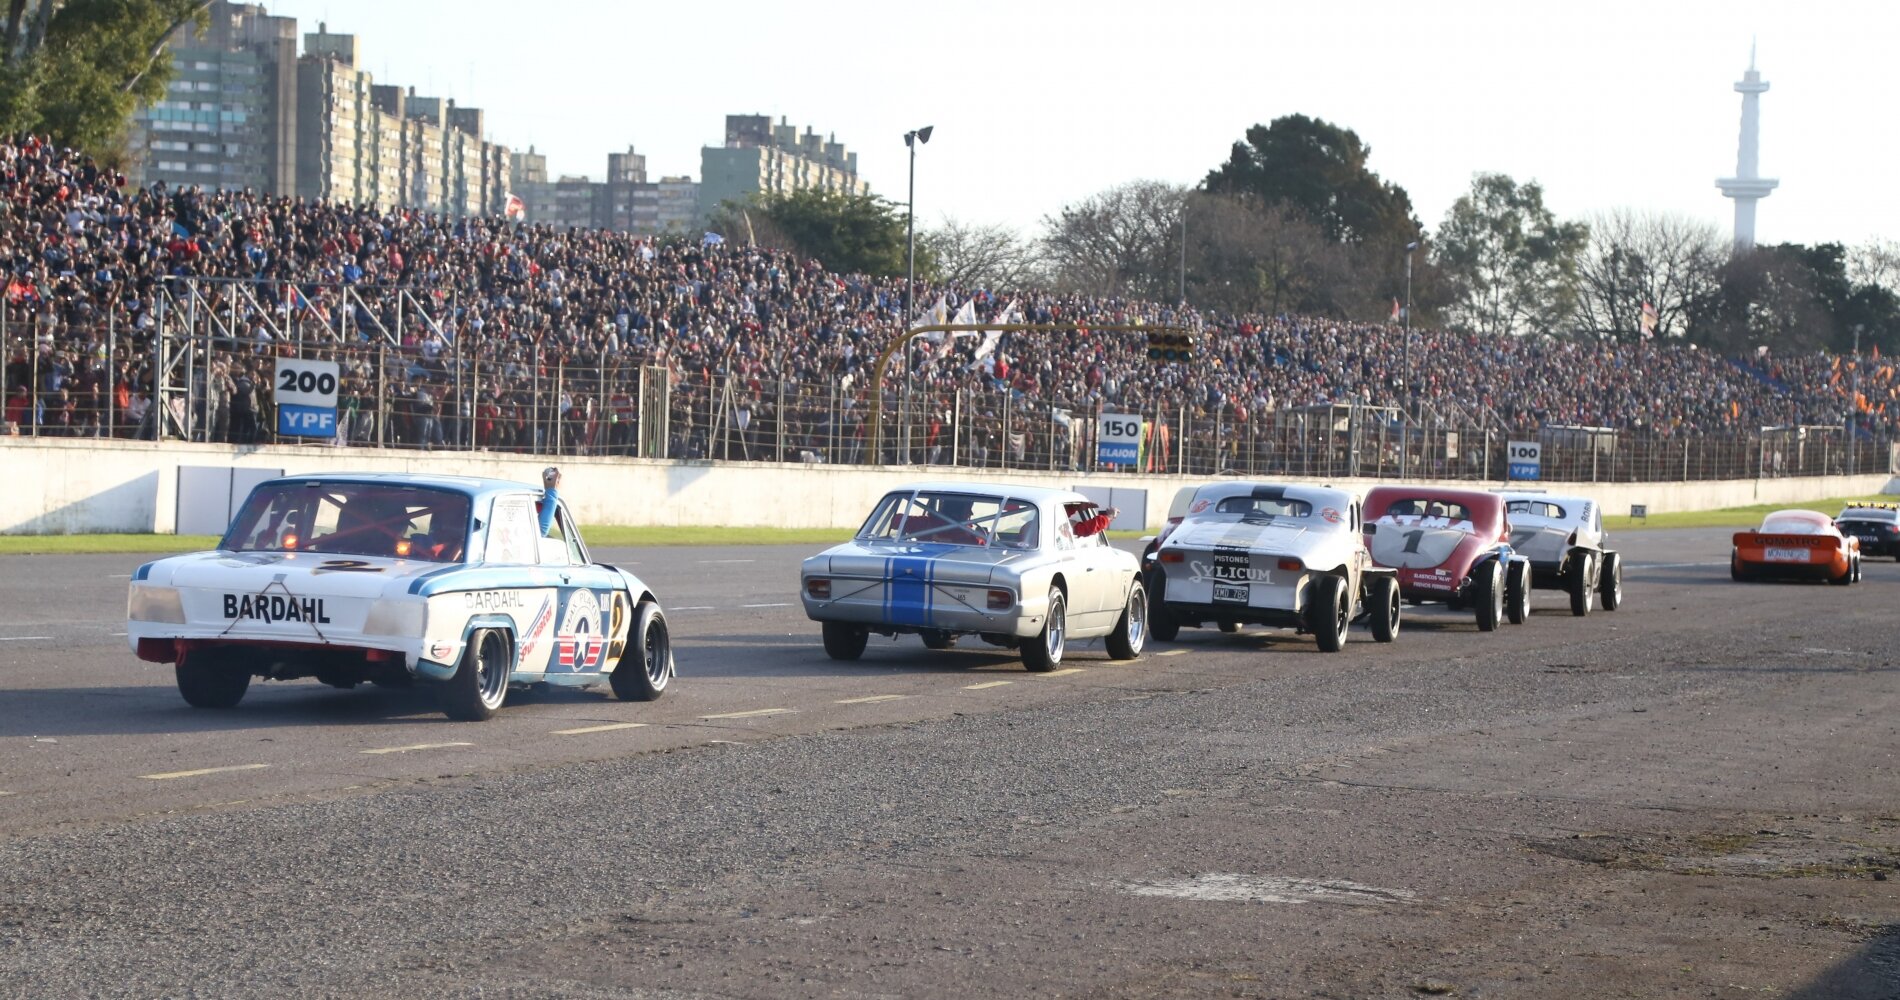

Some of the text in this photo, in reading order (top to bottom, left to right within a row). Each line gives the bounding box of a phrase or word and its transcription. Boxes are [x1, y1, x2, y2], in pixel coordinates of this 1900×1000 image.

[278, 369, 336, 395] 200
[284, 411, 334, 429] YPF
[1103, 420, 1138, 437] 150
[1099, 447, 1137, 458] ELAION
[1511, 447, 1538, 459] 100
[1513, 466, 1537, 475] YPF
[1402, 529, 1425, 554] 1
[311, 560, 386, 576] 2
[1214, 555, 1249, 564] PISTONES
[1189, 560, 1274, 586] SYLICUM
[1215, 588, 1248, 600] XMD 782
[223, 593, 331, 624] BARDAHL
[519, 604, 553, 662] Purlator
